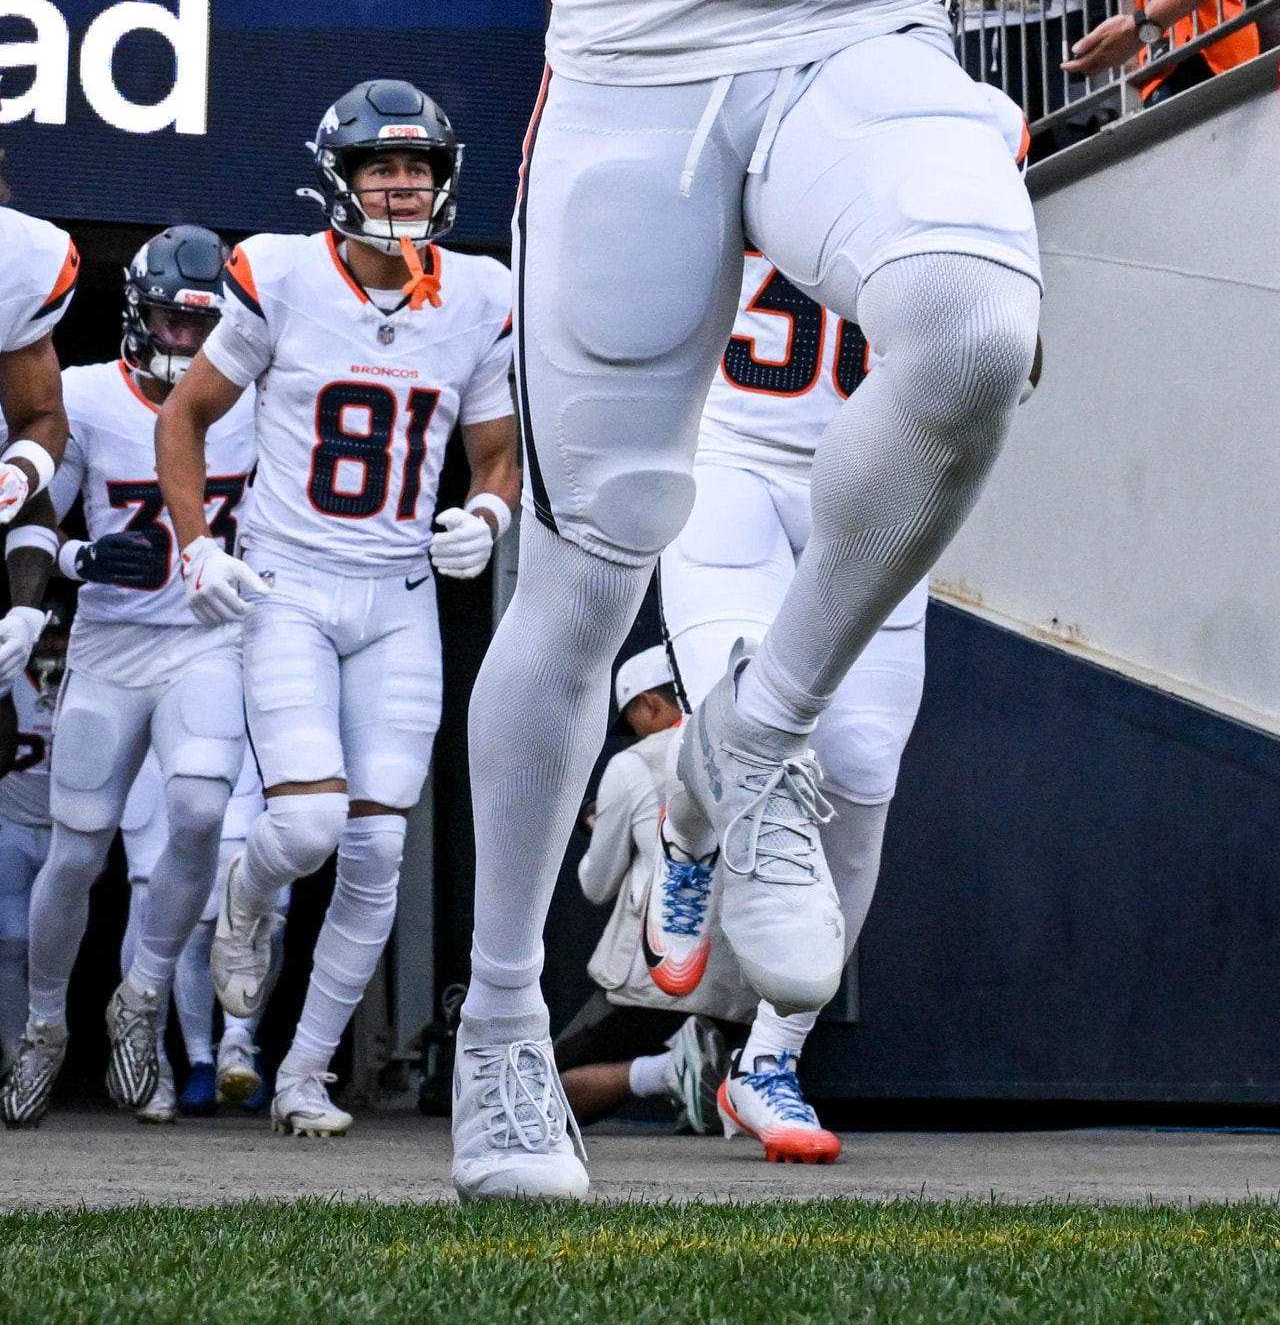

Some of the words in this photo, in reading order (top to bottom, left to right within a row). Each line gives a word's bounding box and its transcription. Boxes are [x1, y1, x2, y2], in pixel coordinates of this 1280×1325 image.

[349, 364, 419, 380] BRONCOS
[719, 238, 871, 402] 3
[307, 379, 442, 522] 81
